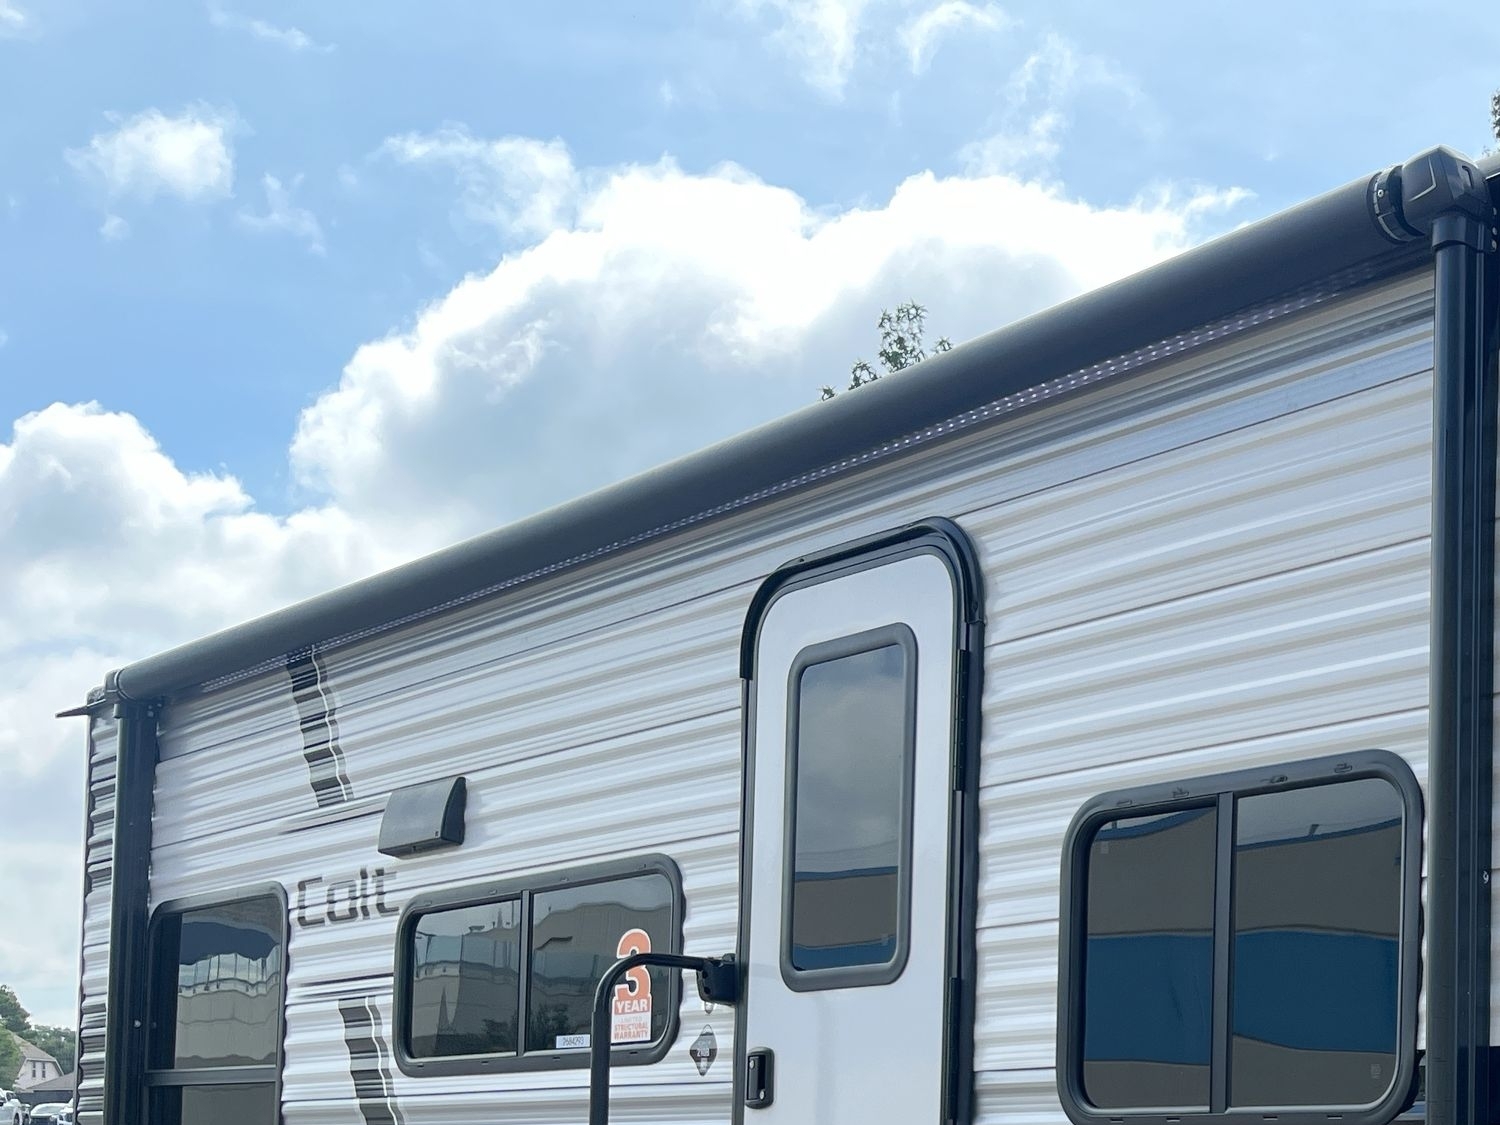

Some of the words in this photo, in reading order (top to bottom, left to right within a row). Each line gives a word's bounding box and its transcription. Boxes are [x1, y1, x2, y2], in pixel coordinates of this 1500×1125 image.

[297, 867, 400, 929] Colt
[616, 929, 652, 1001] 3
[617, 998, 649, 1014] YEAR
[614, 1021, 649, 1032] STRUCTURAL
[614, 1029, 648, 1040] WARRANTY
